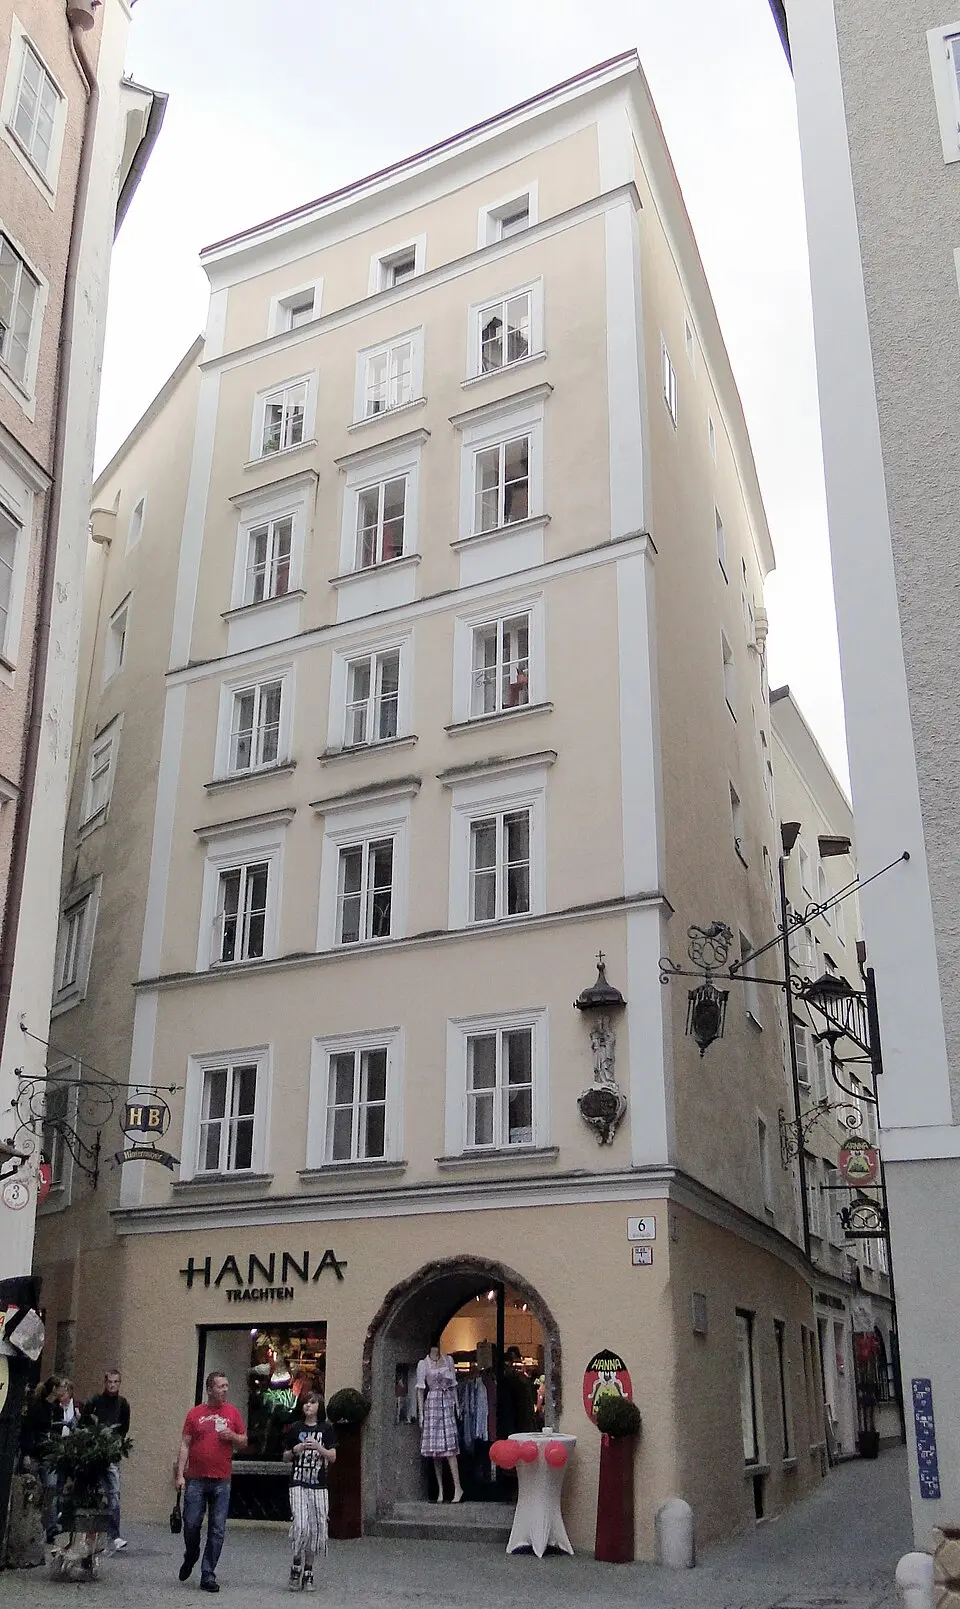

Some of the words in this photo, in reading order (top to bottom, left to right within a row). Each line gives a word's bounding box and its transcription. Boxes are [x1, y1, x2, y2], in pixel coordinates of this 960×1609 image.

[12, 1184, 20, 1200] 3
[638, 1219, 646, 1231] 6
[179, 1249, 348, 1288] HANNA
[226, 1286, 294, 1302] TRACHTEN
[591, 1358, 622, 1371] HANNA
